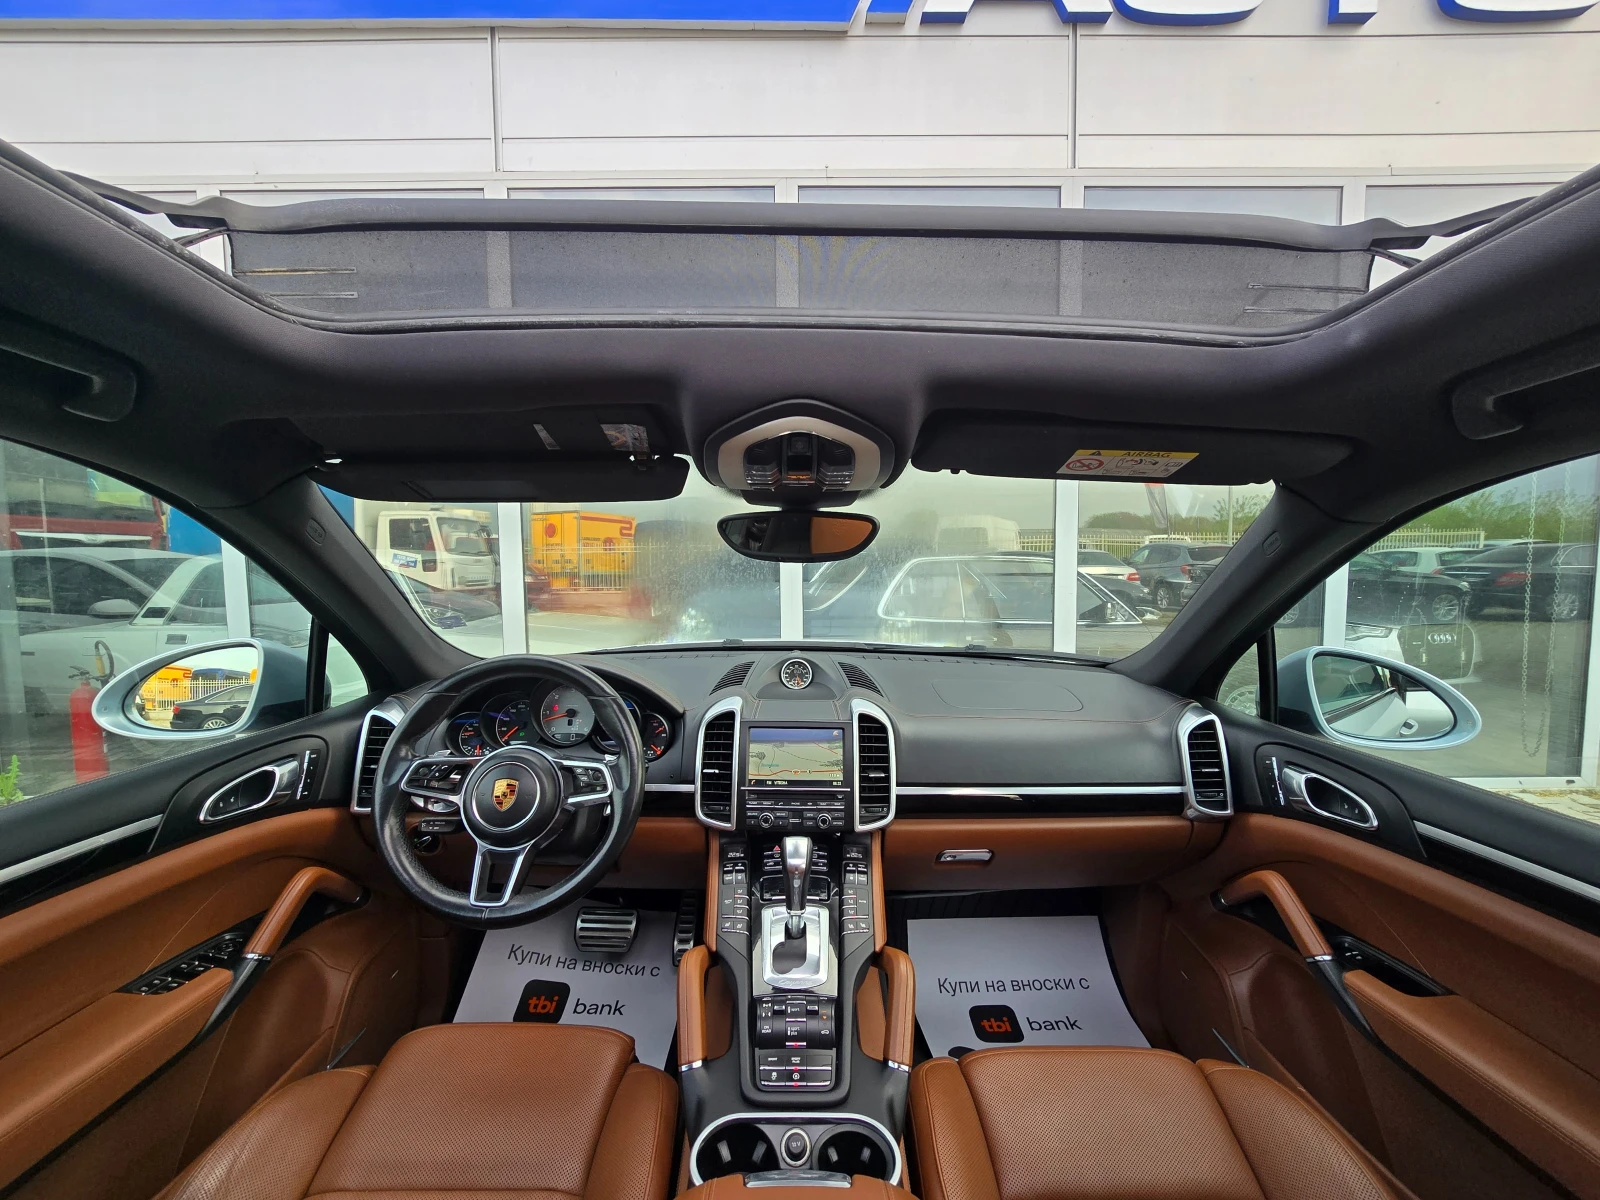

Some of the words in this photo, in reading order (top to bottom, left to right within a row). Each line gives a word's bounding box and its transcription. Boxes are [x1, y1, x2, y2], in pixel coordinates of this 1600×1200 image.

[507, 943, 552, 967] Купи
[555, 955, 577, 970] на
[582, 958, 645, 977] вноски
[650, 966, 661, 977] с
[937, 977, 980, 997] Купи
[985, 980, 1007, 993] на
[1011, 977, 1075, 992] вноски
[1079, 977, 1090, 990] с
[527, 995, 559, 1014] tbi
[572, 997, 626, 1016] bank
[980, 1017, 1013, 1033] tbi
[1026, 1015, 1083, 1032] bank
